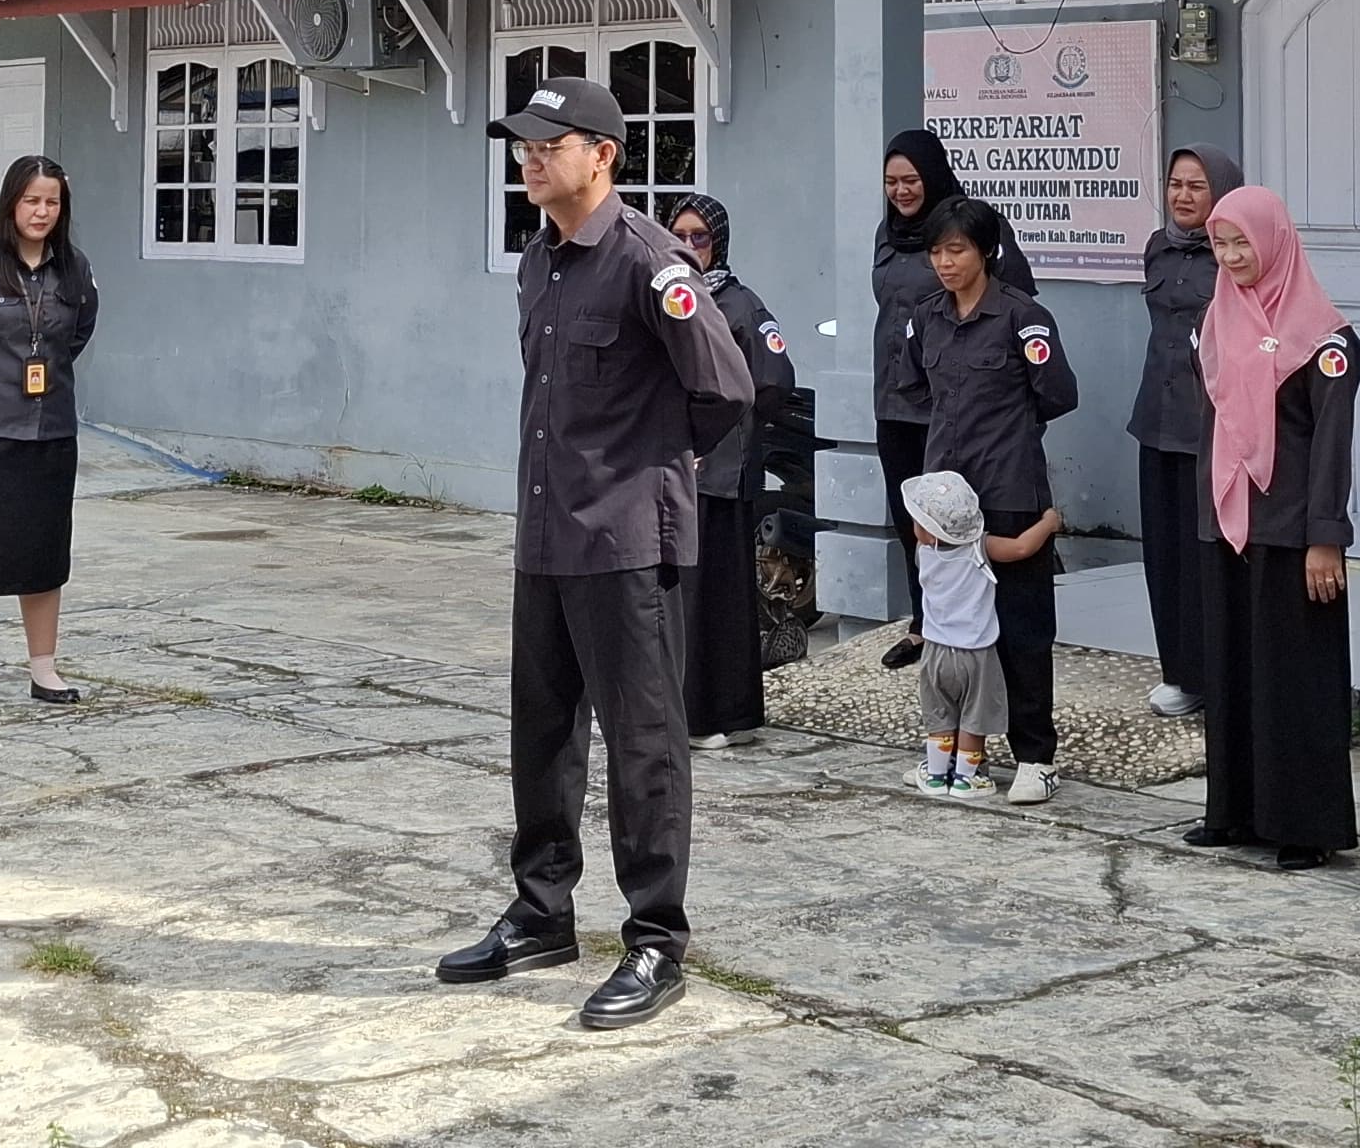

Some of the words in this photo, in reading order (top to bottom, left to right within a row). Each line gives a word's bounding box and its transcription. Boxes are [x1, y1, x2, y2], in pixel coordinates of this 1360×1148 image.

[924, 88, 958, 99] WASLU
[926, 114, 1084, 139] SEKRETARIAT
[986, 147, 1121, 171] GAKKUMDU
[959, 180, 1016, 198] GAKKAN
[1019, 180, 1071, 198] HUKUM
[1074, 180, 1139, 198] TERPADU
[1026, 203, 1072, 221] UTARA
[1016, 229, 1047, 243] Teweh
[1048, 230, 1068, 243] Kab.
[1069, 230, 1098, 244] Barito
[1099, 231, 1126, 245] Utara
